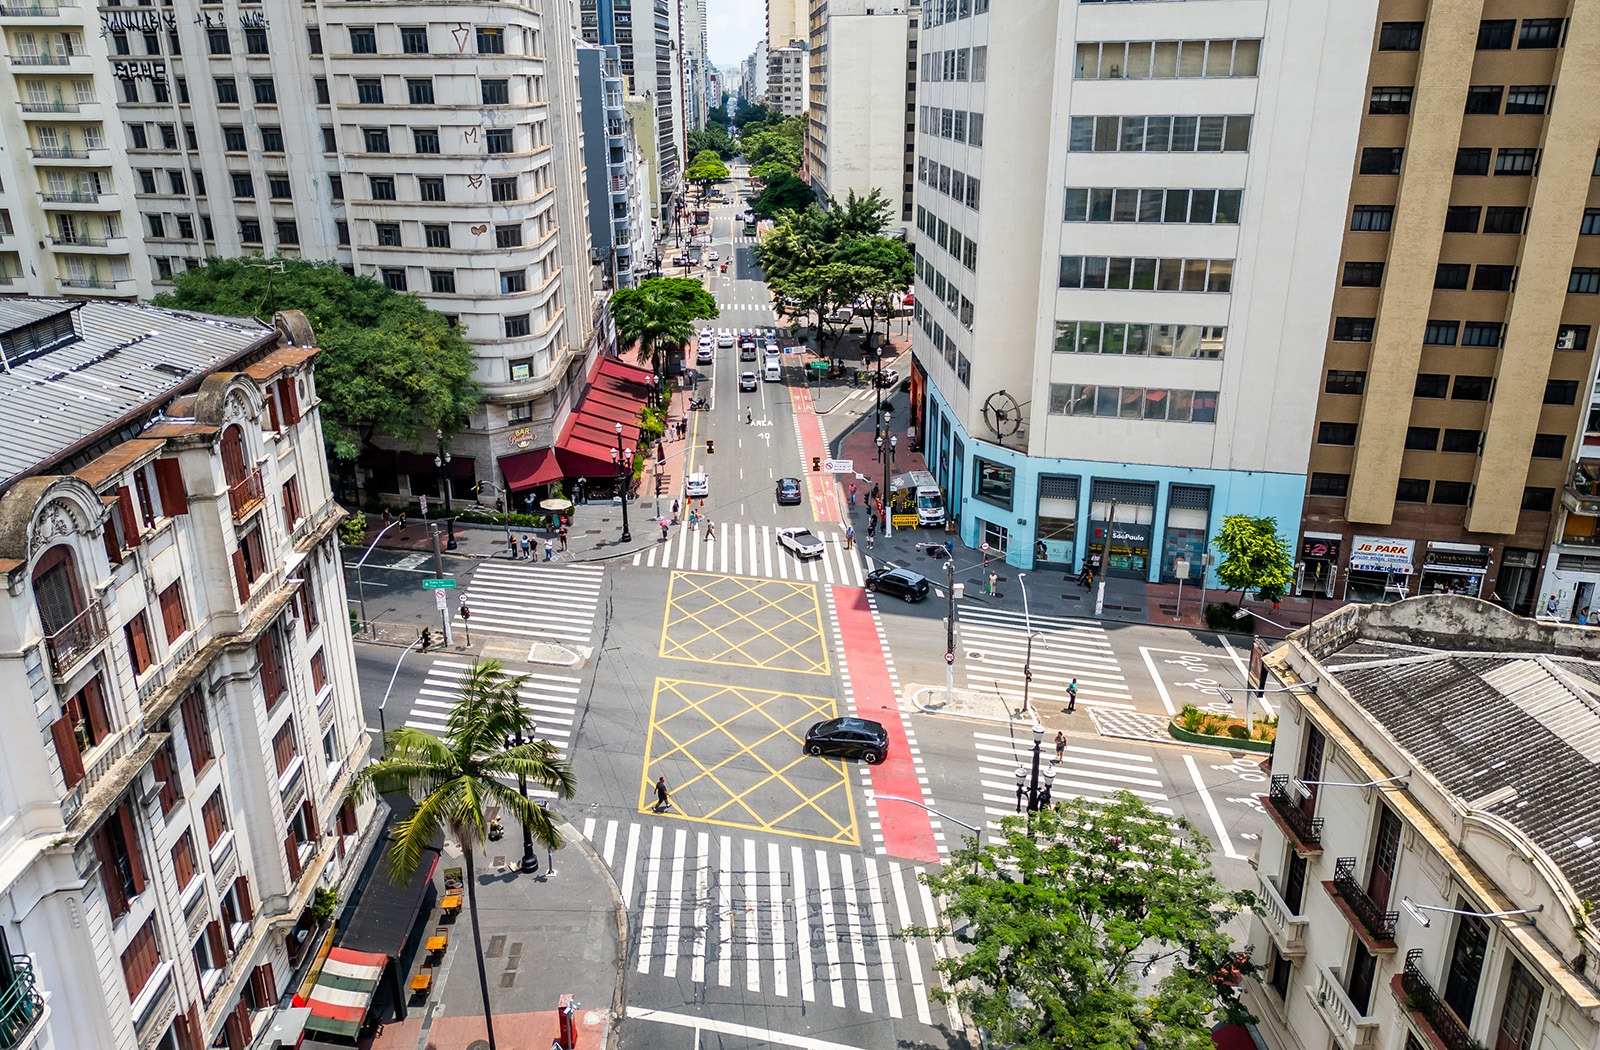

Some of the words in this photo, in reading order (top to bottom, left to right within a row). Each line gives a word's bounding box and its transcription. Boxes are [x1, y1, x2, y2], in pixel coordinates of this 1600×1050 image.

[514, 427, 530, 437] BAR
[1357, 543, 1372, 551] JB
[1374, 544, 1408, 554] PARK
